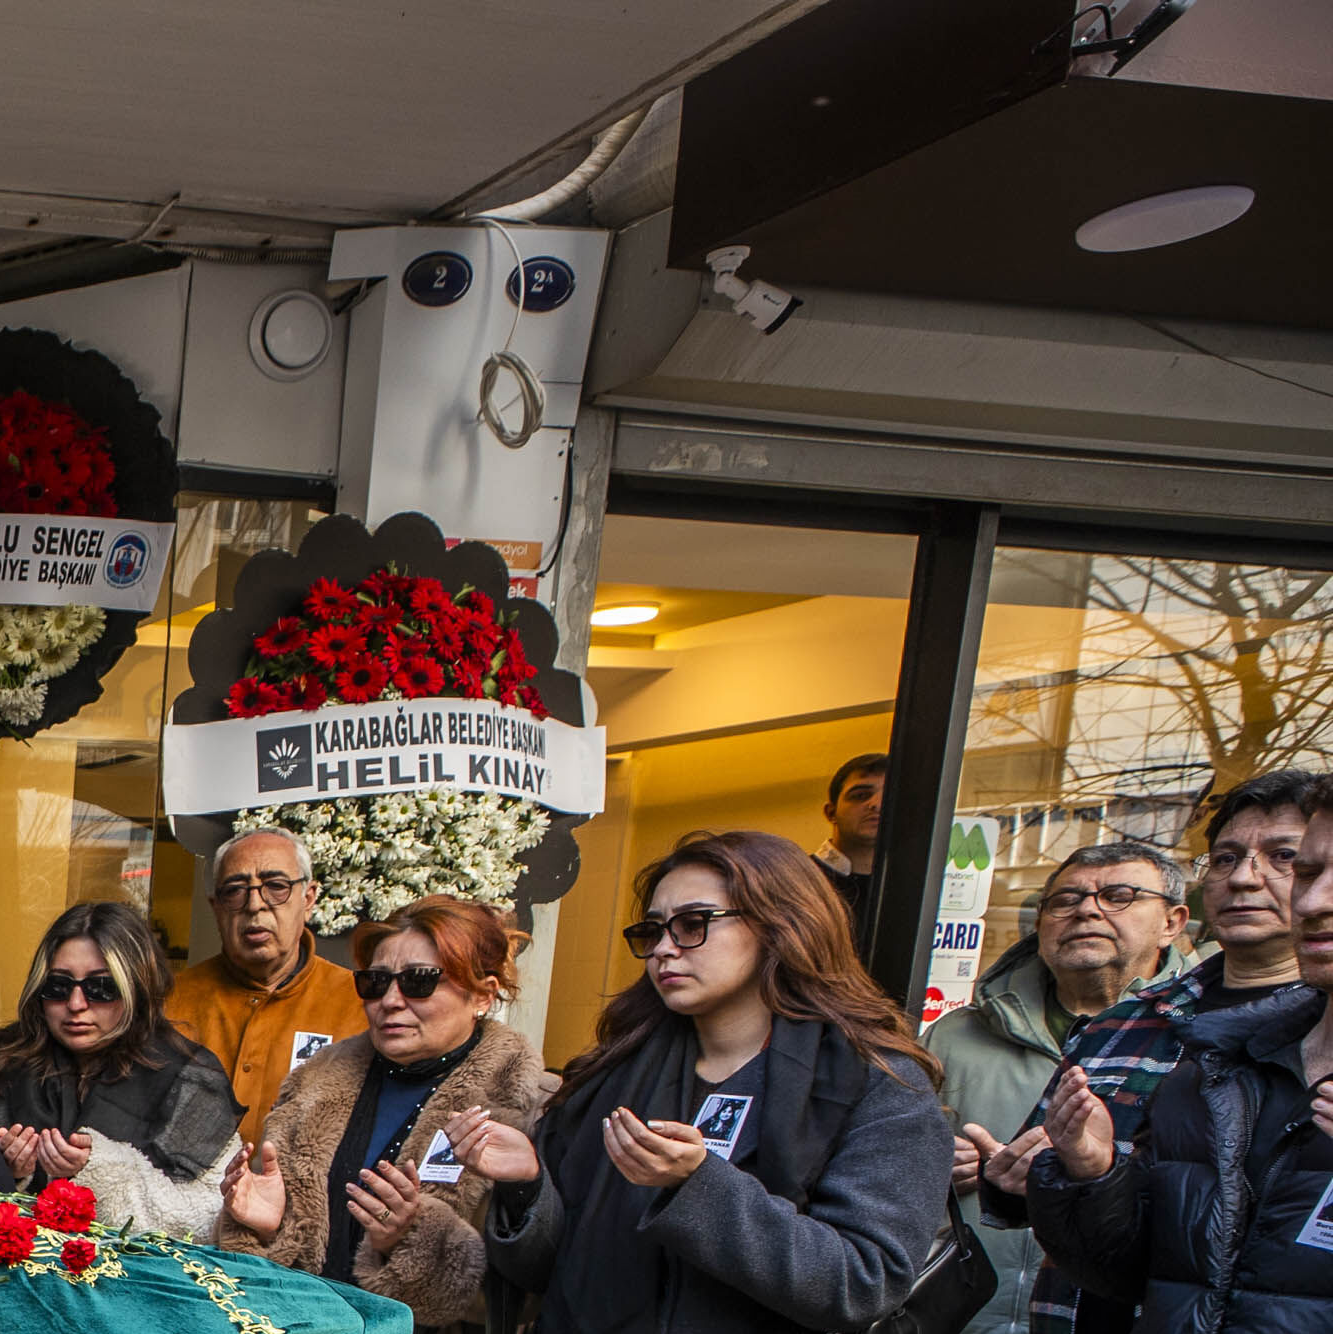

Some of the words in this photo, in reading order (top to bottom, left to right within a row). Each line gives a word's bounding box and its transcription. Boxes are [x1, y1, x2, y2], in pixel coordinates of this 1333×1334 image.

[433, 265, 448, 288] 2
[530, 269, 554, 293] 2A
[32, 526, 105, 559] SENGEL
[38, 560, 98, 590] BAŞKANI
[315, 706, 445, 754] KARABAĞLAR
[448, 707, 510, 748] BELEDİYE
[468, 754, 546, 795] KINAY
